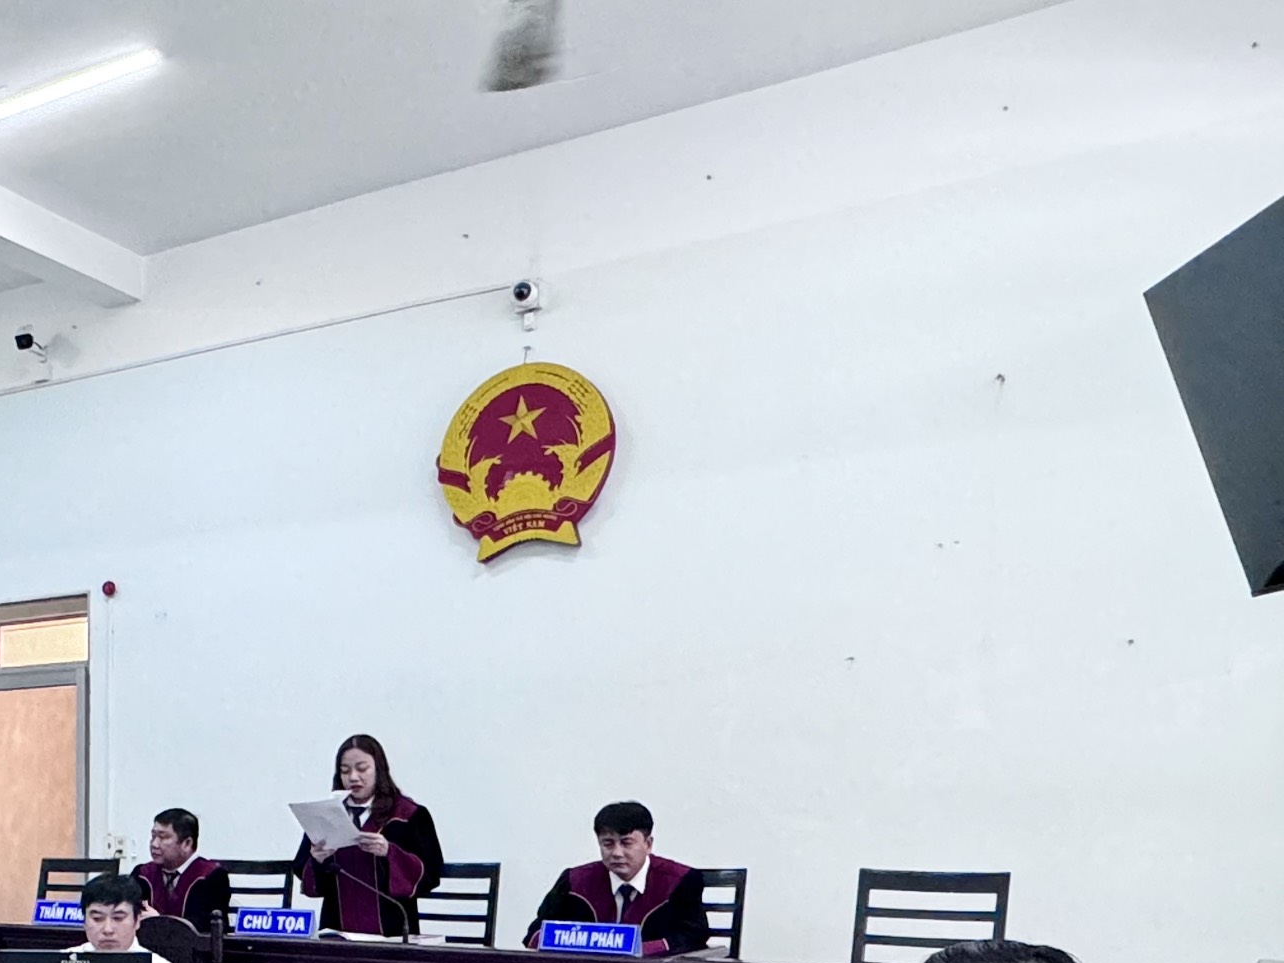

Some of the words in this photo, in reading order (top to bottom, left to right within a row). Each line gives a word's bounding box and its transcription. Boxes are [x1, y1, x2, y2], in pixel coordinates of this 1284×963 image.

[242, 910, 273, 930] CHỦ
[276, 915, 306, 934] TỌA
[554, 925, 589, 947] THẨM
[589, 928, 625, 949] PHÁN
